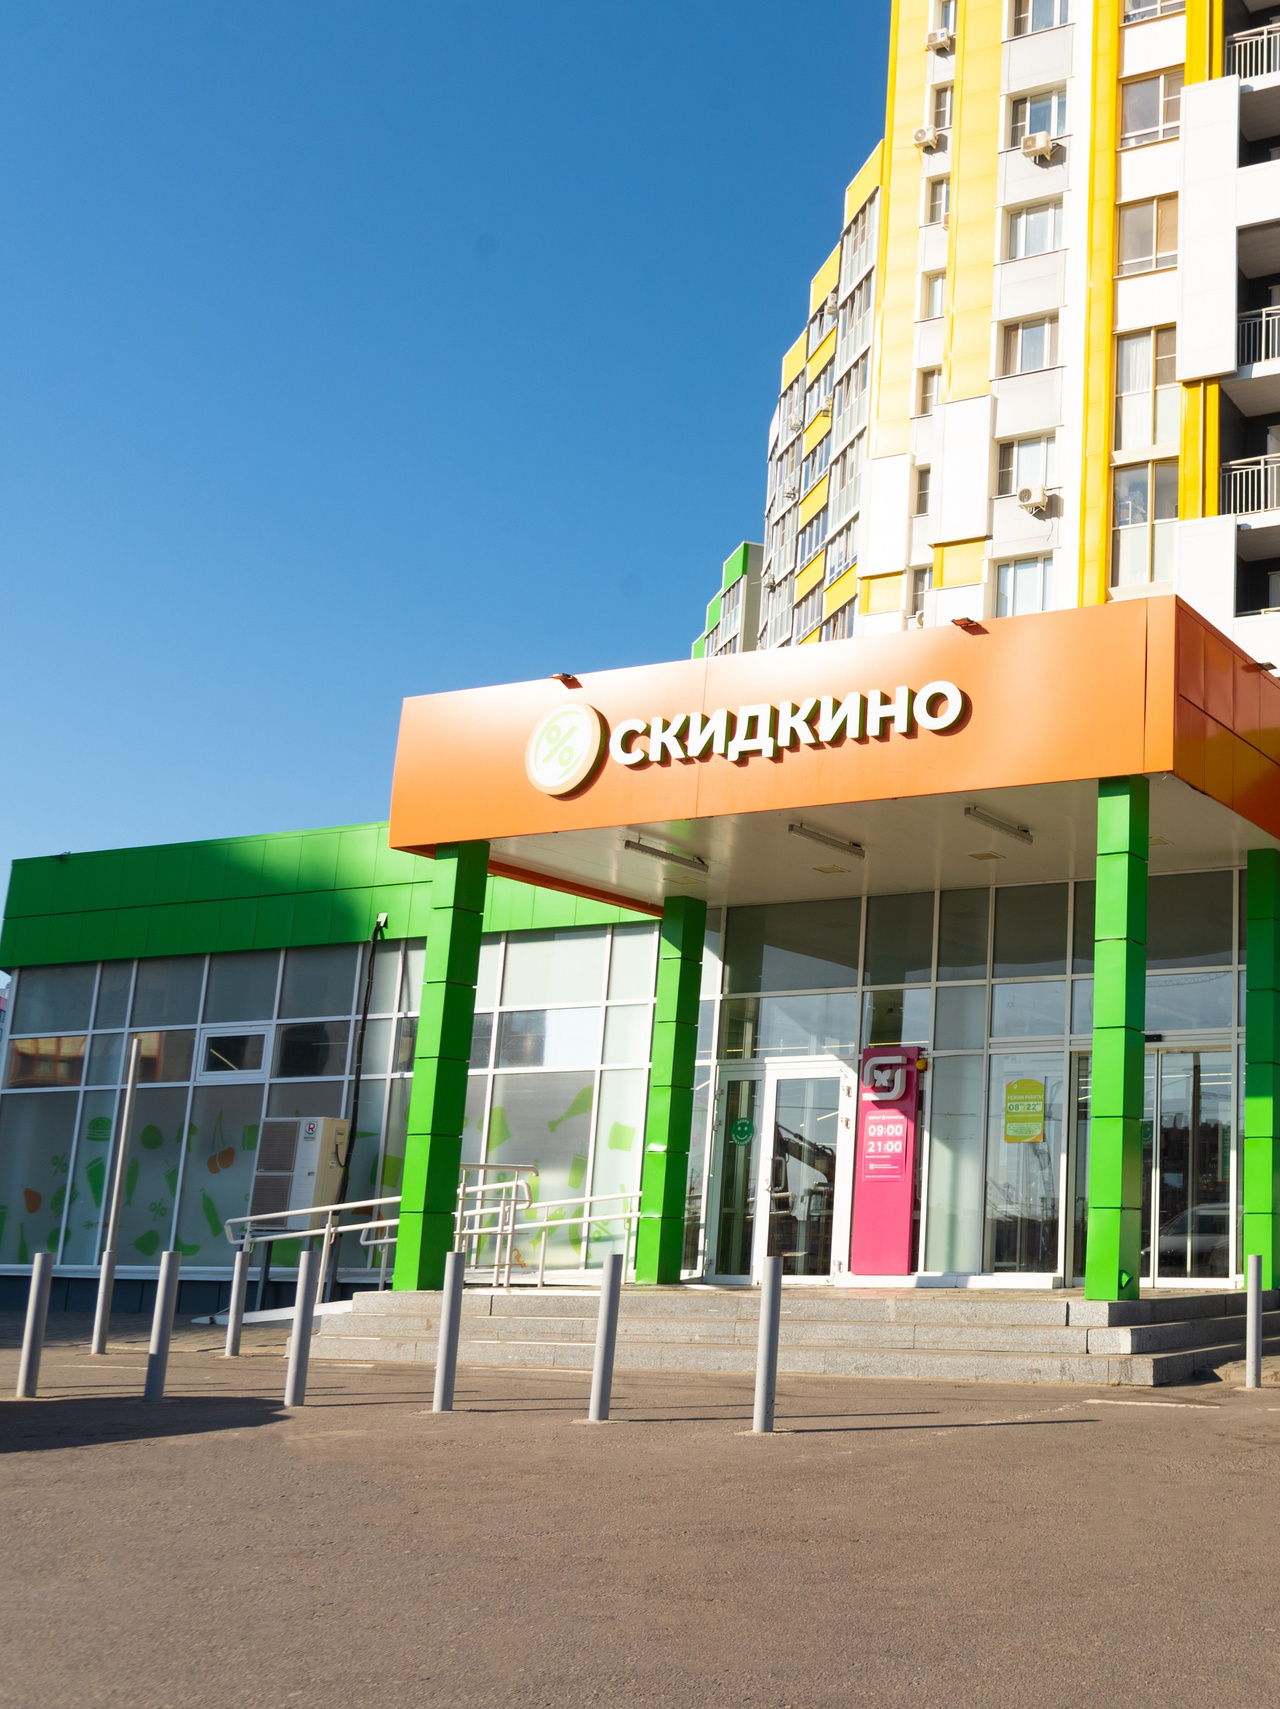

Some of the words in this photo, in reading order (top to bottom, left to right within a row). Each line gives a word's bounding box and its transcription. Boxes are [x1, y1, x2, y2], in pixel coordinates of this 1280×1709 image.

[608, 680, 967, 767] СКИДКИНО
[868, 1124, 903, 1136] 09:00
[868, 1141, 903, 1152] 21:00
